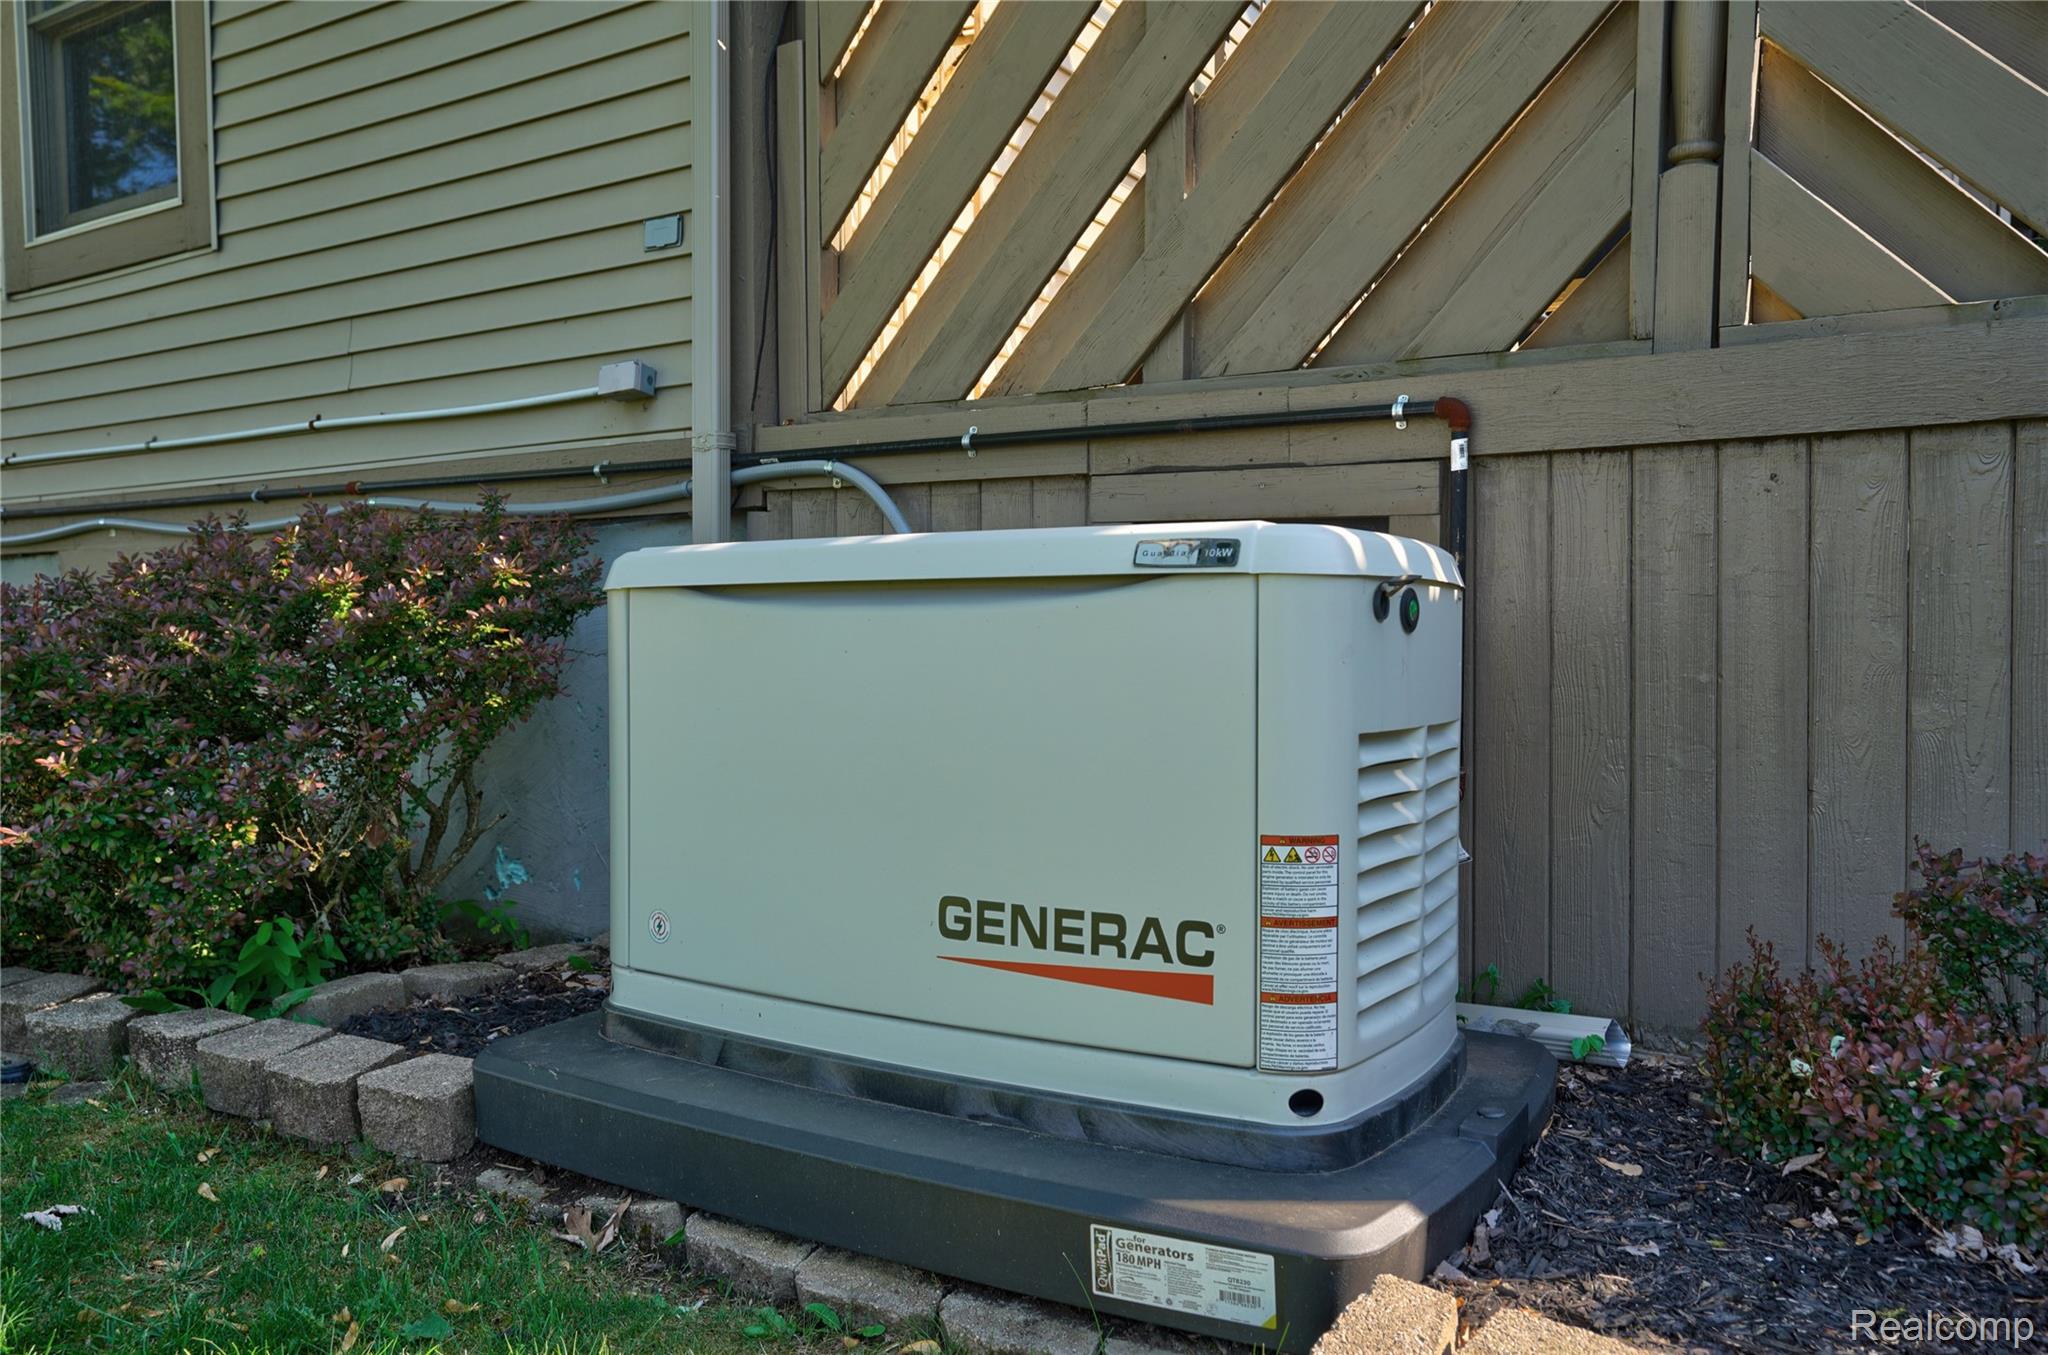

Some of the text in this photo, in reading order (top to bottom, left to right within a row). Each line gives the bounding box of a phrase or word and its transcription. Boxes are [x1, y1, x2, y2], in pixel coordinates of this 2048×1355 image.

[1204, 547, 1233, 557] 10kW
[938, 895, 1215, 968] GENERAC
[1133, 1234, 1146, 1244] for
[1115, 1238, 1194, 1262] Generators
[1115, 1251, 1135, 1265] 180
[1137, 1255, 1161, 1270] MPH
